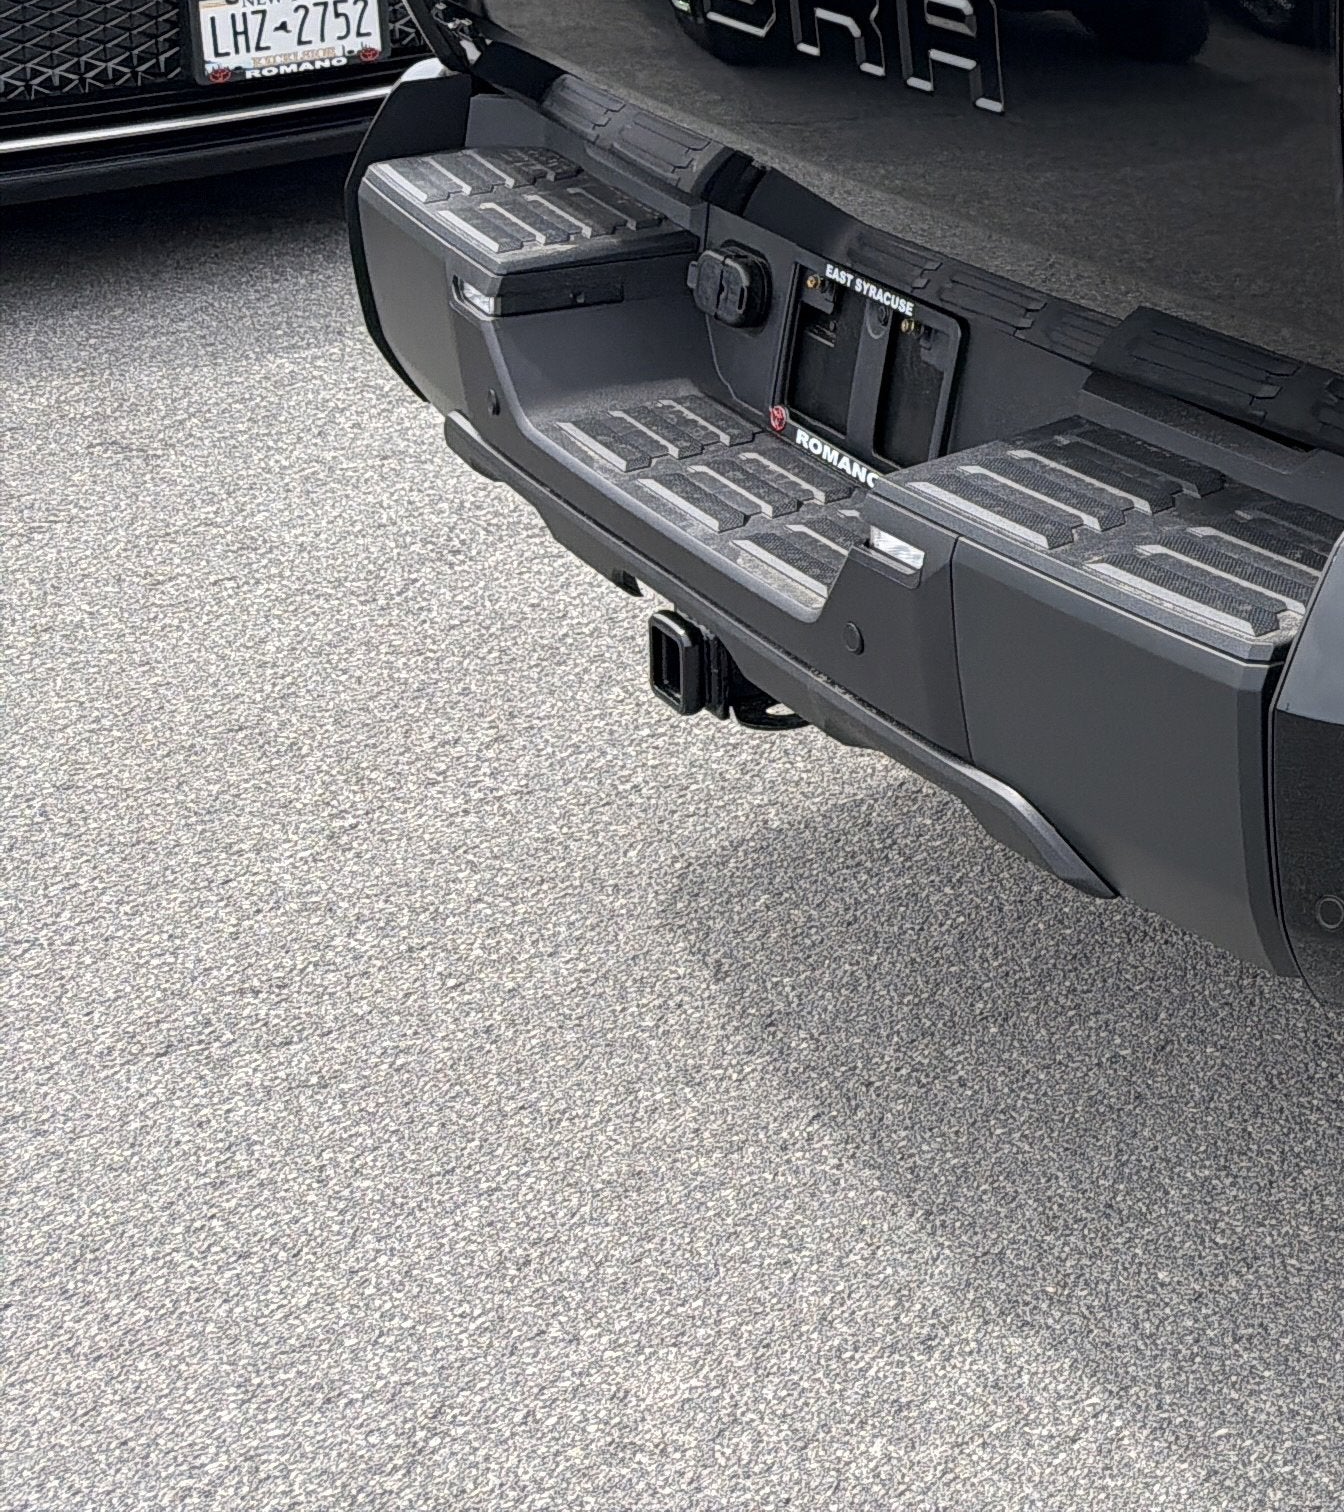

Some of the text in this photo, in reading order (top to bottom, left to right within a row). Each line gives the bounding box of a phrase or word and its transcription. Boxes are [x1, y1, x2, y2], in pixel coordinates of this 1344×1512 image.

[209, 9, 272, 58] LHZ
[245, 56, 348, 79] ROMANO
[825, 263, 915, 317] EAST SYRACUSE
